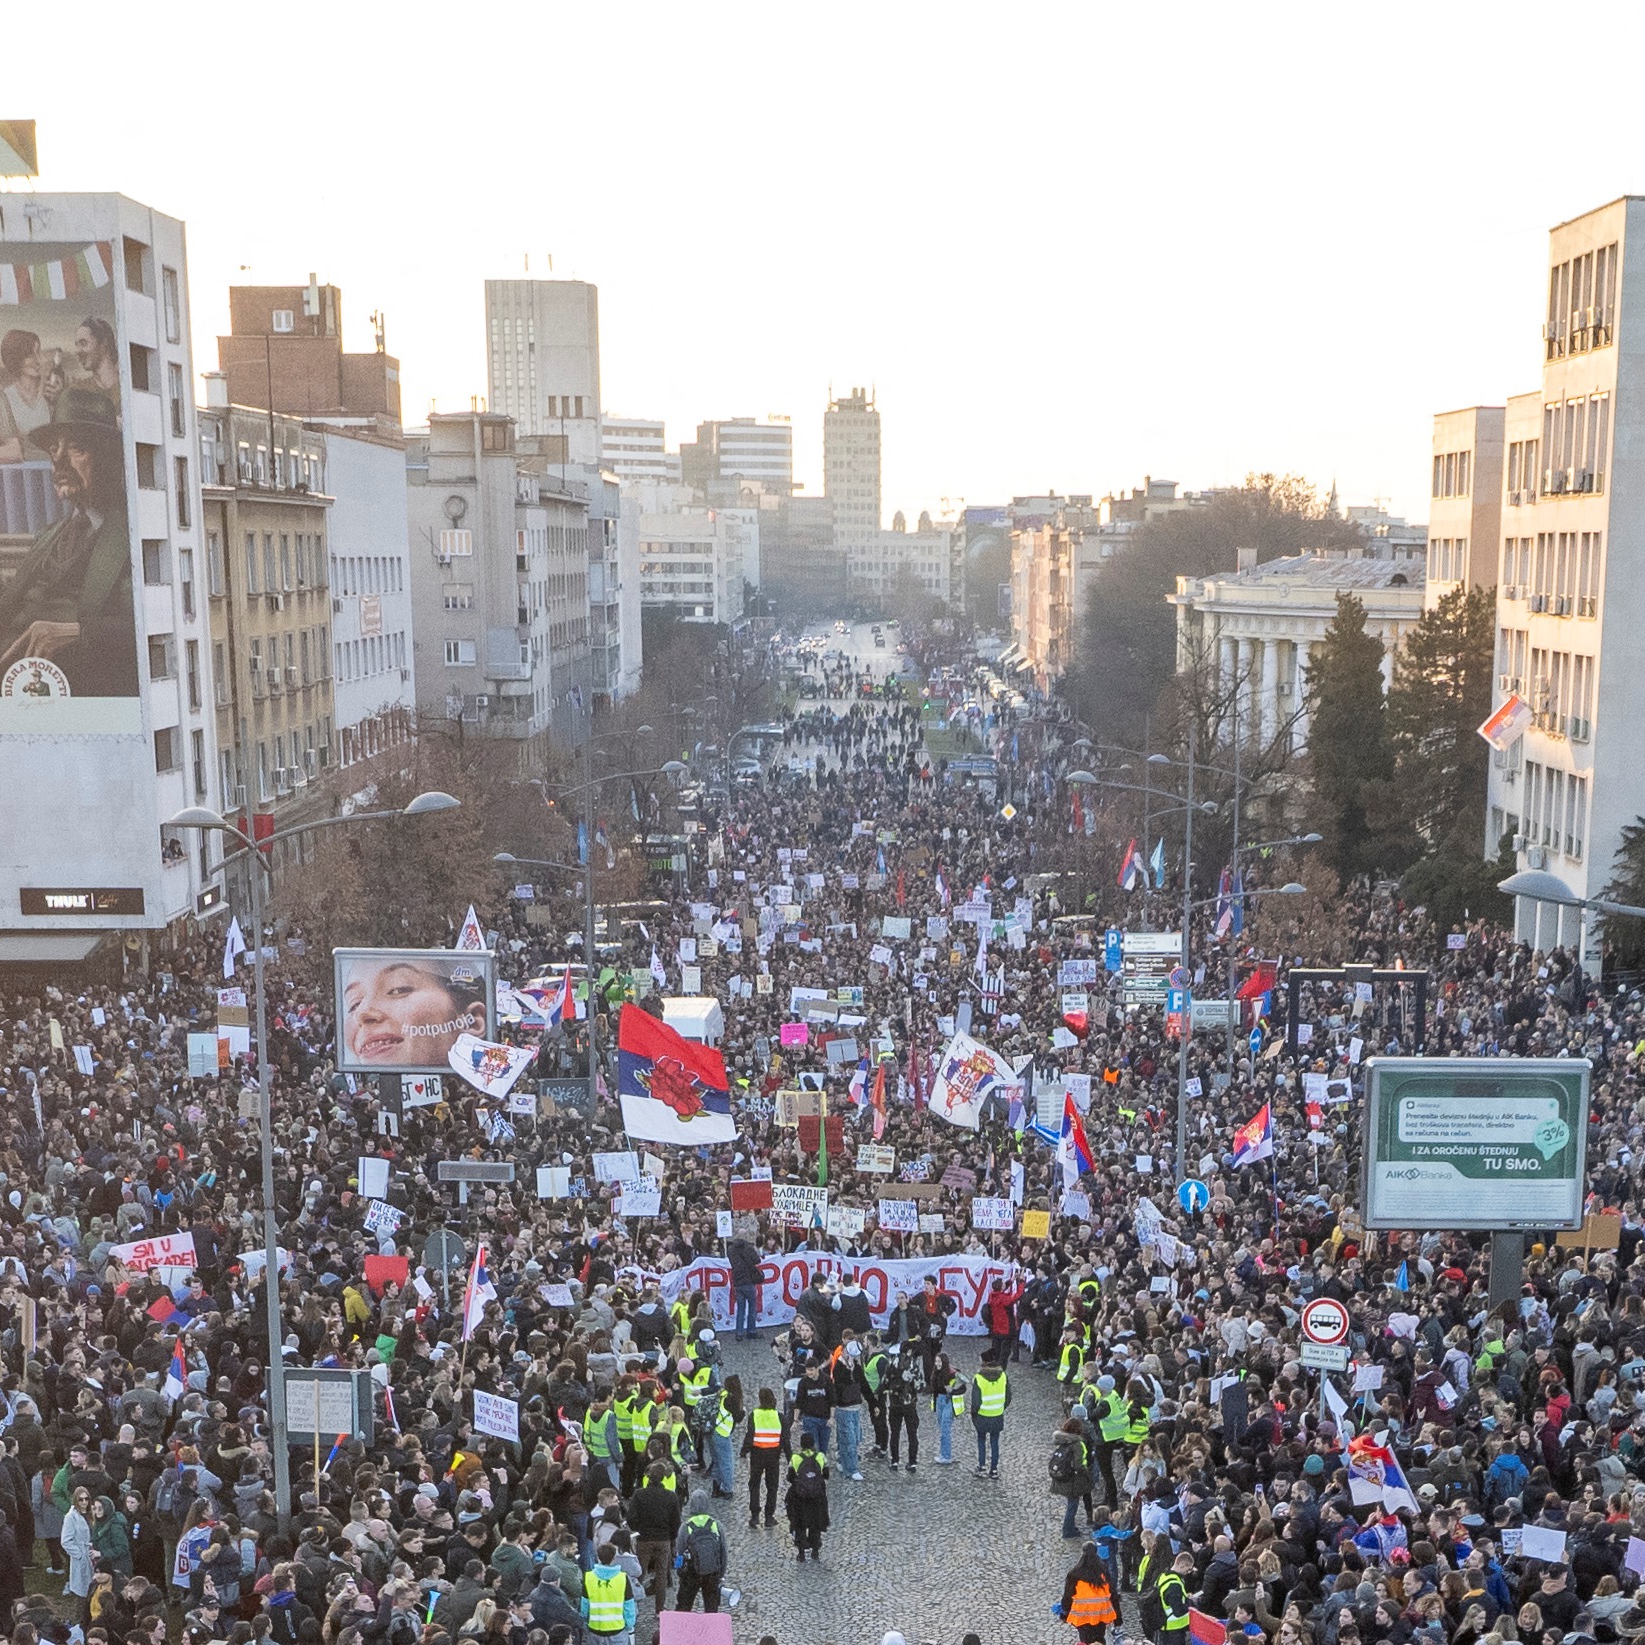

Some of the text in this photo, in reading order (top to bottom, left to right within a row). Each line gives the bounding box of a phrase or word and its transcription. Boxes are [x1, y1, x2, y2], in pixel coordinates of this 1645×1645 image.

[1109, 933, 1117, 947] P
[401, 1013, 475, 1038] #potpunoja
[1432, 1146, 1477, 1155] OROČENU
[1479, 1146, 1519, 1155] ŠTEDNJU
[1483, 1158, 1541, 1170] TU SMO.
[772, 1188, 826, 1201] БЛОКАДНЕ
[159, 1239, 171, 1253] U
